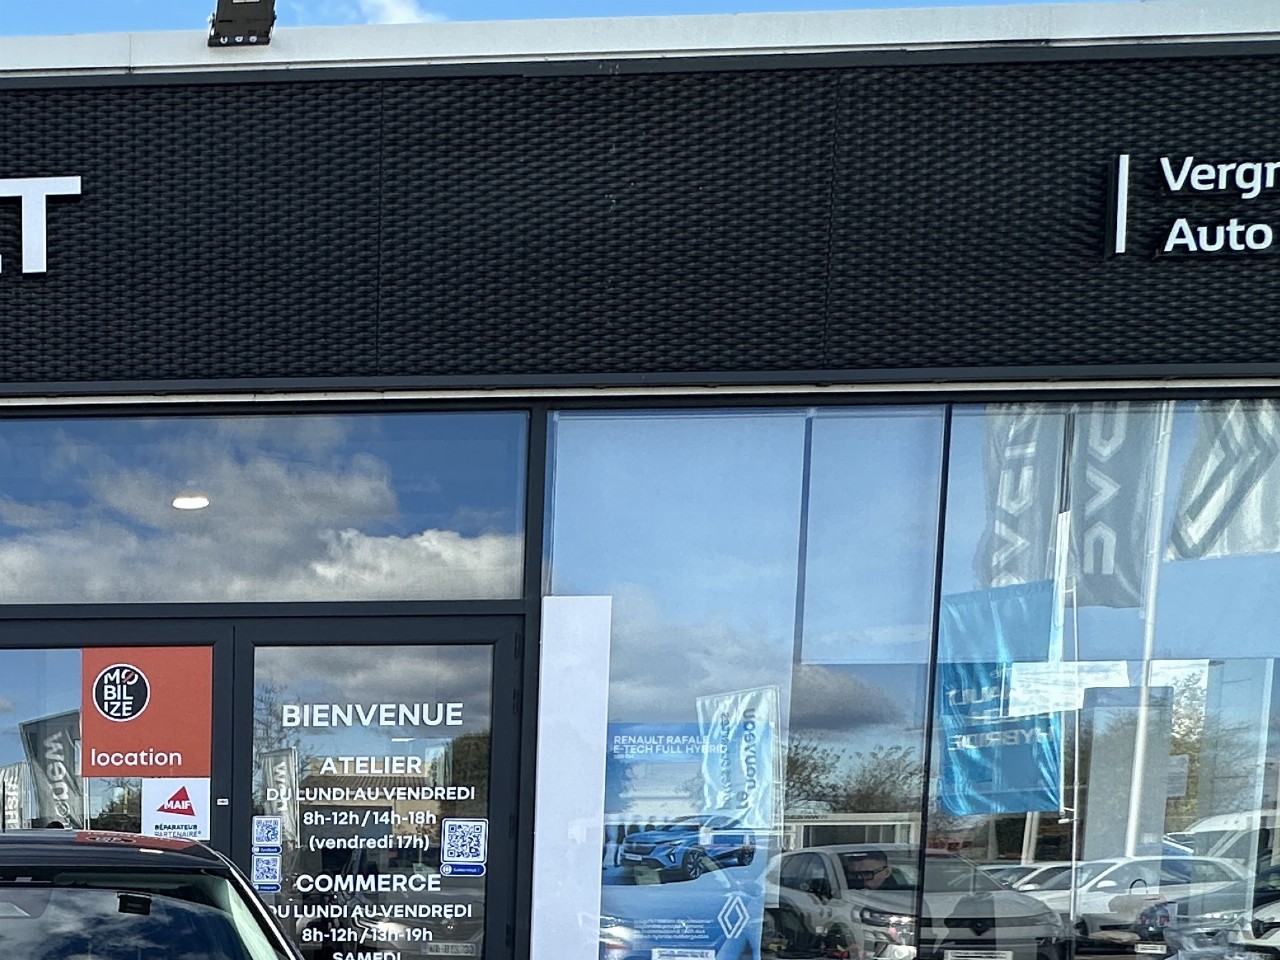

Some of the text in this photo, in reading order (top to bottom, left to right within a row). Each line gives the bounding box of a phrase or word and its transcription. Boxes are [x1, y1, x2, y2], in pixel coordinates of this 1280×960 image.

[1164, 218, 1273, 252] Auto
[282, 702, 464, 727] BIENVENUE
[613, 735, 665, 744] RENAULT
[91, 748, 182, 766] location
[613, 745, 653, 754] E-TECH
[655, 745, 683, 754] FULL
[319, 755, 422, 775] ATELIER
[266, 786, 475, 801] DU LUNDI AU VENDREDI
[163, 800, 191, 810] MAIF
[303, 811, 360, 825] 8h-12h
[372, 811, 437, 825] 14h-18h
[309, 835, 430, 851] (vendredi 17h)
[296, 873, 441, 893] COMMERCE
[293, 904, 348, 918] LUNDI
[350, 904, 378, 918] AU
[380, 904, 472, 918] VENDREDI
[301, 928, 358, 942] 8h-12h
[371, 928, 433, 942] 13h-19h
